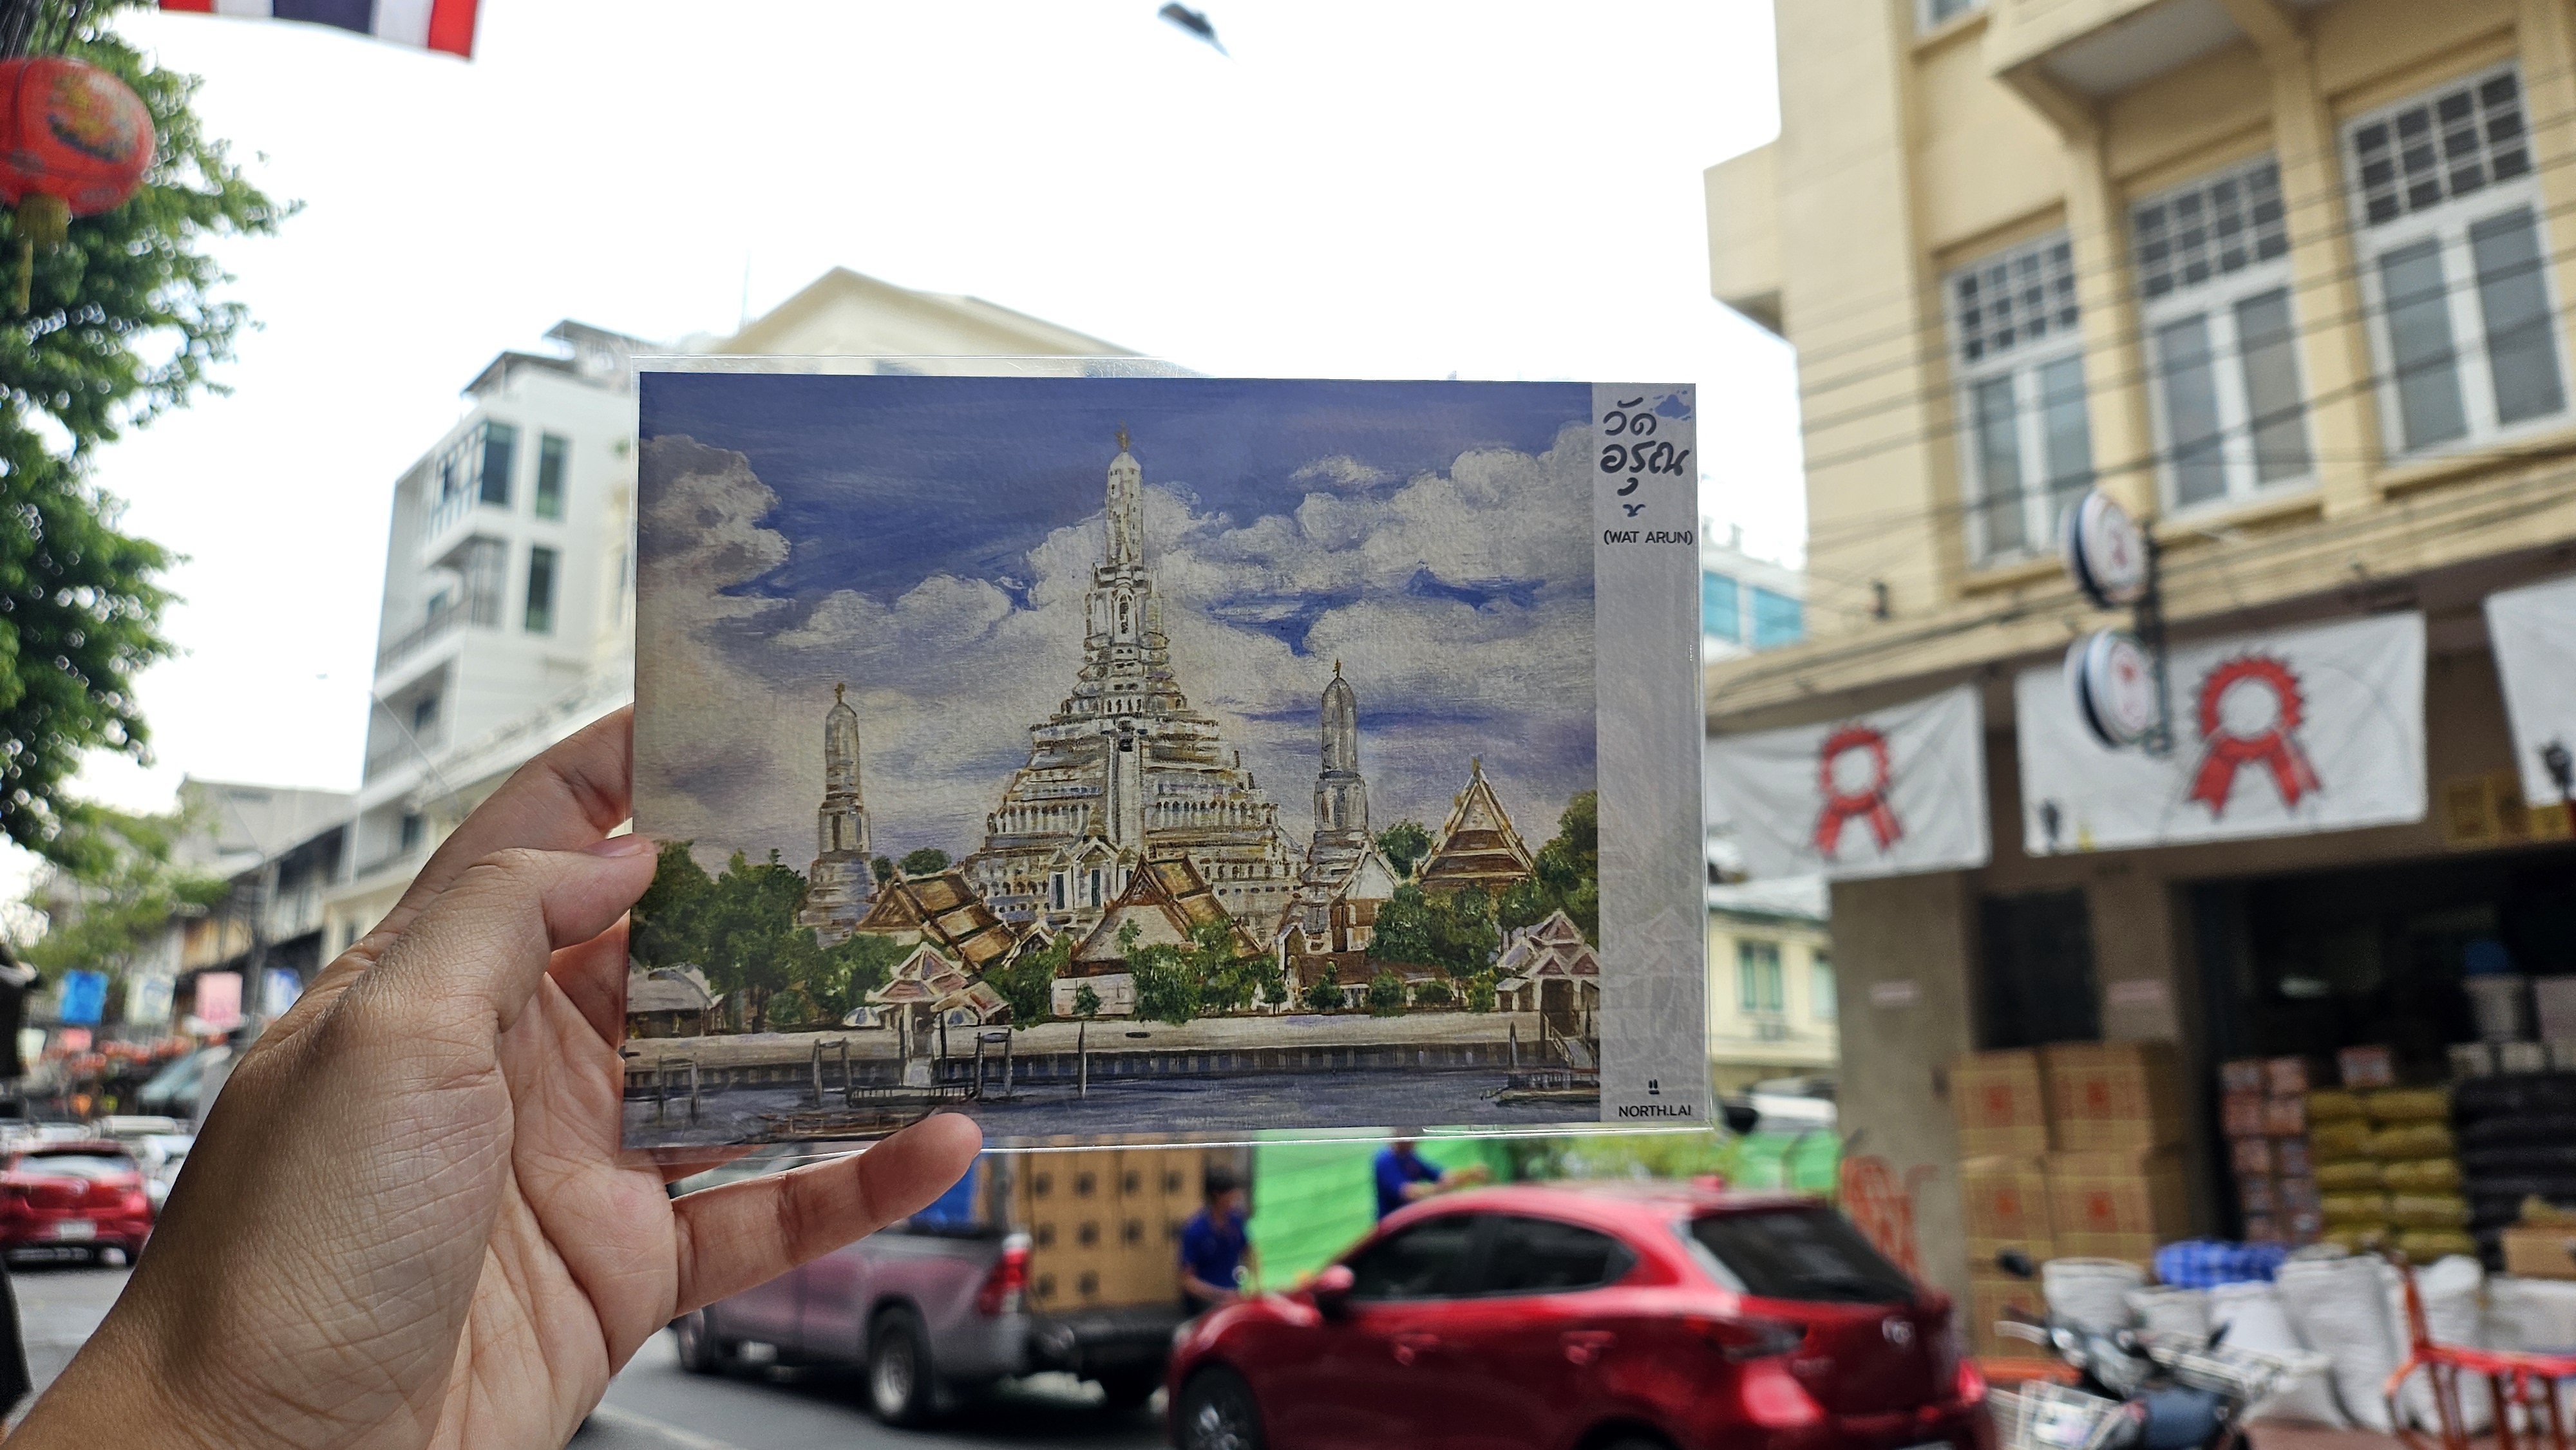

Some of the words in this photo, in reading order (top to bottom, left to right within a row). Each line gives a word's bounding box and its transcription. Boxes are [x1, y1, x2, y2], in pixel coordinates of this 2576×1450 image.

[1603, 397, 1656, 436] วัด
[1600, 440, 1690, 496] อรุณ
[1604, 529, 1640, 545] (WAT
[1645, 530, 1693, 546] ARUN)
[1618, 1104, 1691, 1117] NORTH.LAI
